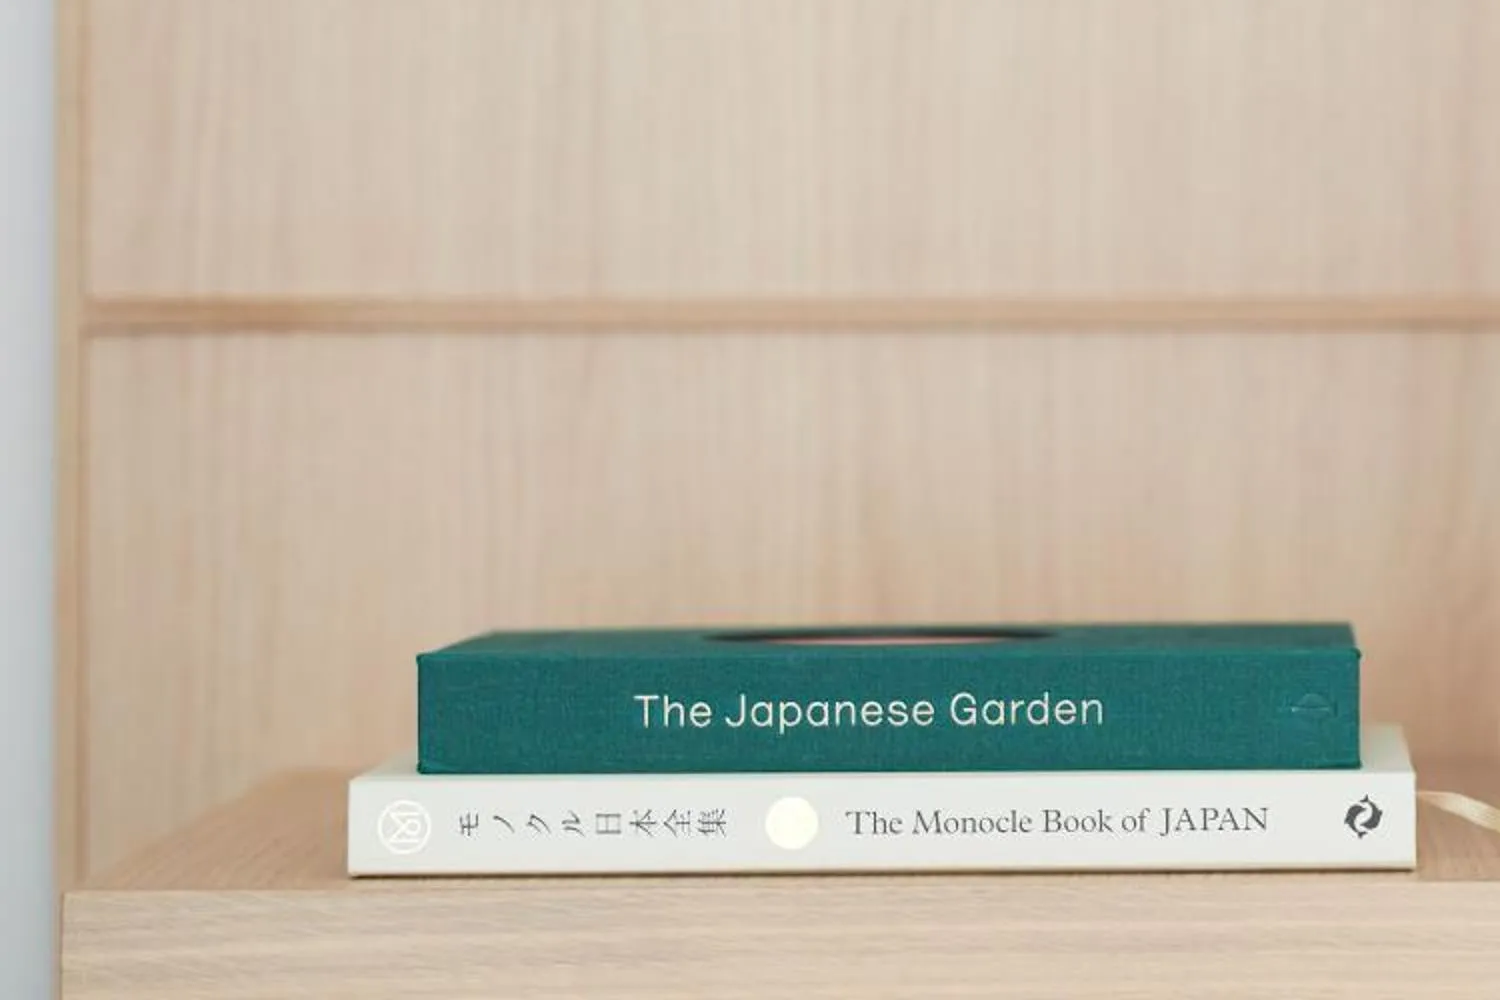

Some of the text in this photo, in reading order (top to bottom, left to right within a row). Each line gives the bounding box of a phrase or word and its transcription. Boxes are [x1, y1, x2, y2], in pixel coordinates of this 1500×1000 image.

[633, 691, 1104, 735] The Japanese Garden
[457, 808, 728, 838] モノクル日本全集
[844, 807, 1269, 837] The Monocle Book of JAPAN
